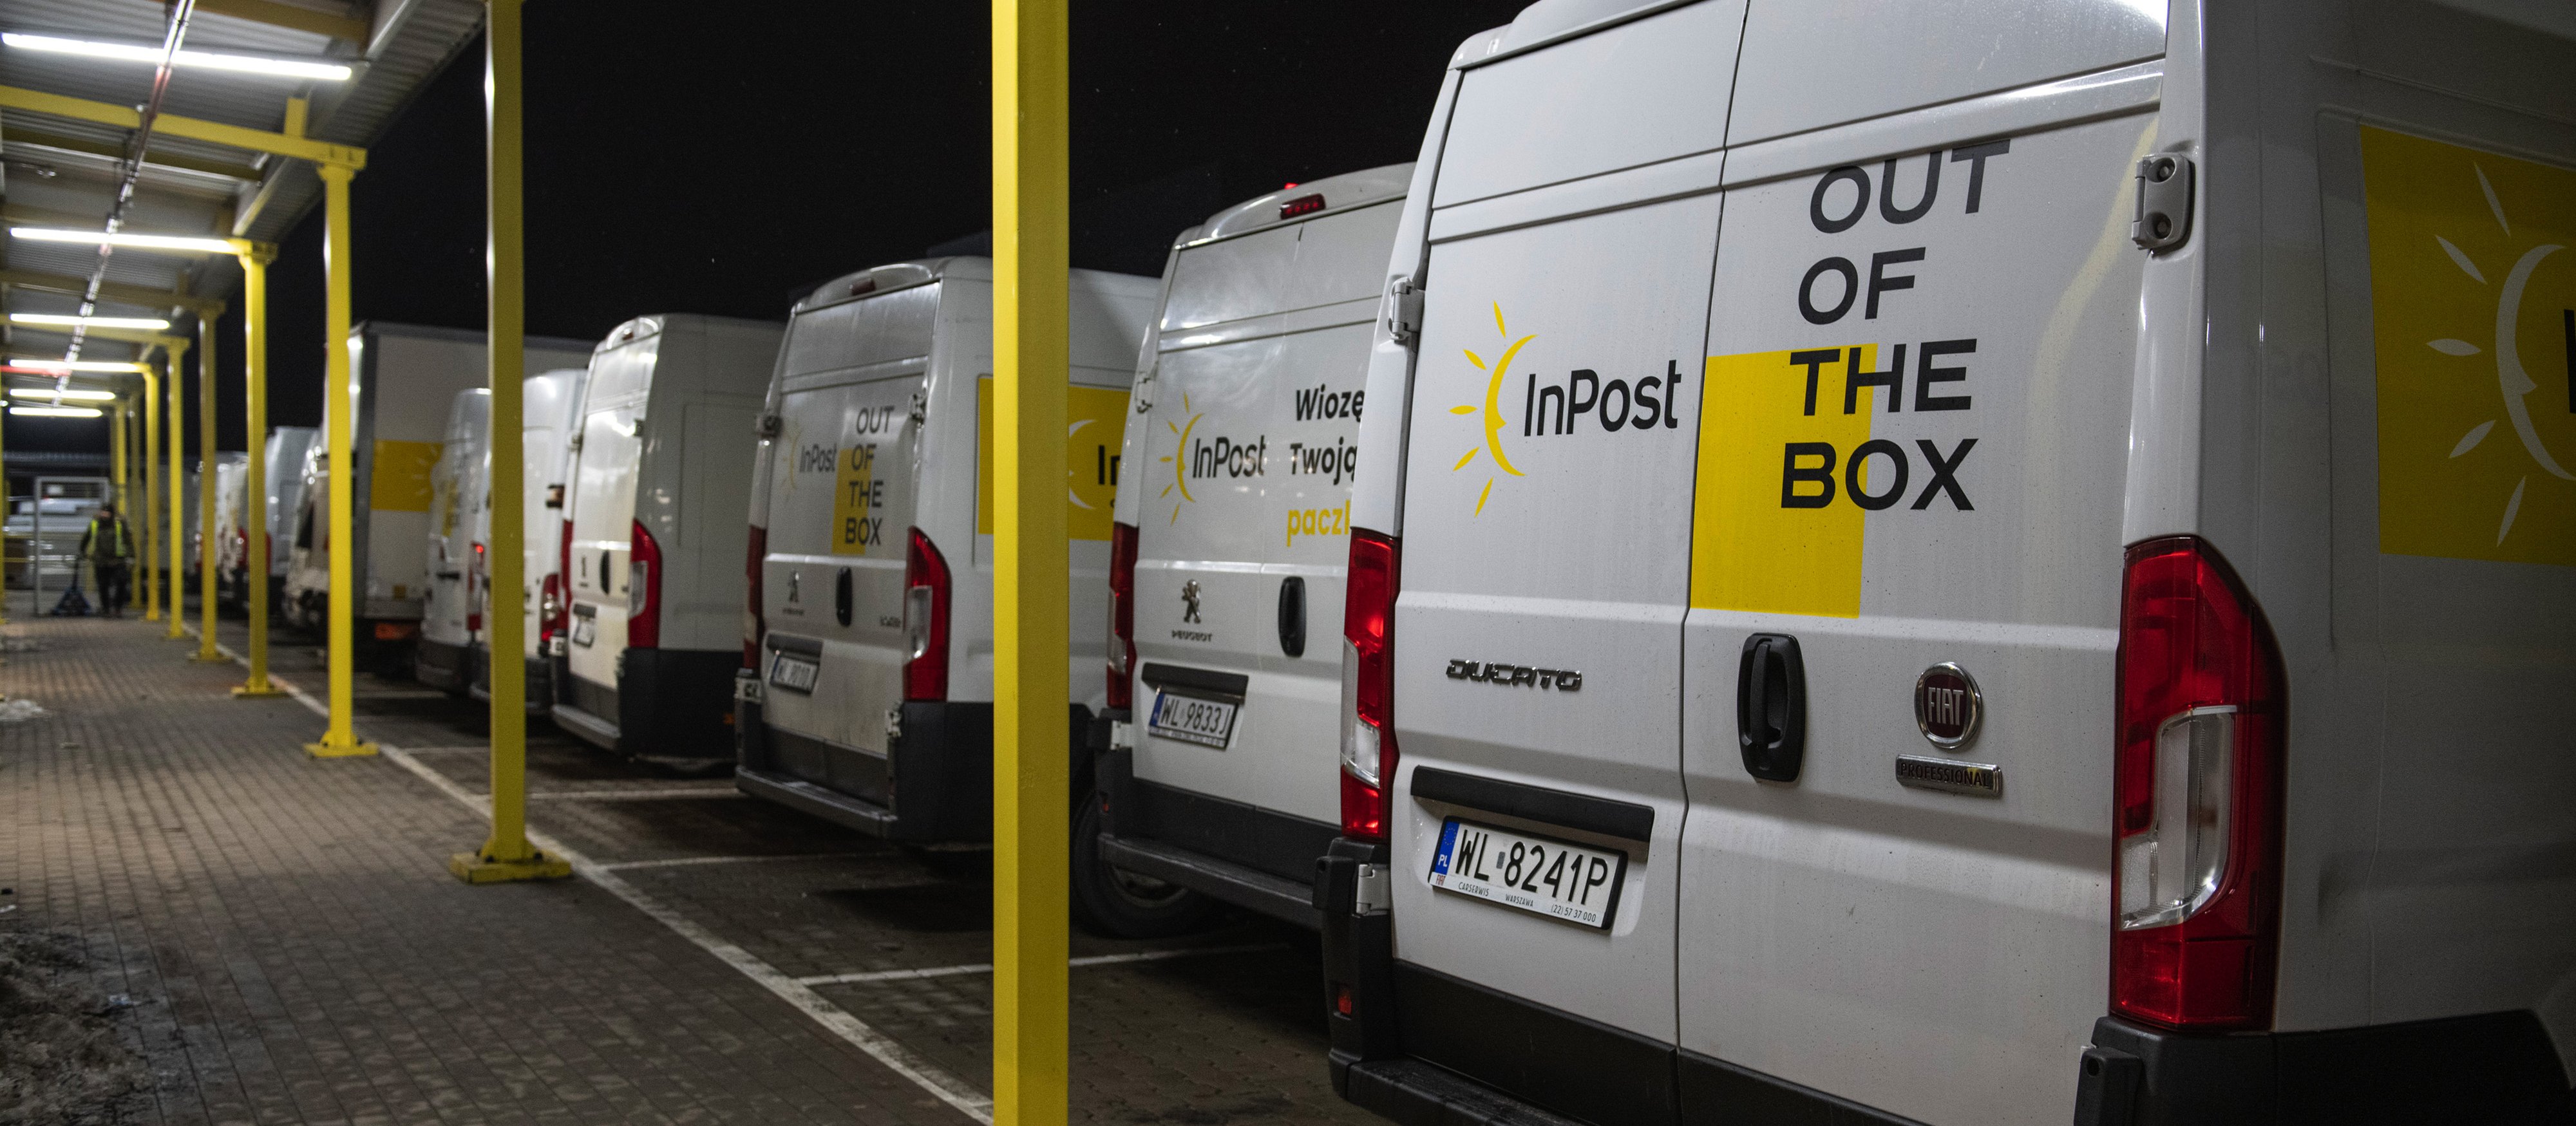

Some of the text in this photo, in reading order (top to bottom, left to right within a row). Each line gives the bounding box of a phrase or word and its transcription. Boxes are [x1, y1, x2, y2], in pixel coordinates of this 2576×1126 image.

[1810, 140, 2010, 234] OUT
[1798, 247, 1926, 324] OF
[1790, 339, 1977, 417] THE
[1296, 384, 1365, 422] Wiozę
[1524, 360, 1681, 436] InPost
[857, 405, 895, 435] OUT
[800, 444, 837, 473] InPost
[851, 444, 877, 471] OF
[1193, 435, 1266, 478] InPost
[1781, 438, 1979, 511] BOX
[849, 480, 884, 507] THE
[845, 517, 882, 546] BOX
[1446, 659, 1582, 691] DUCATO
[1161, 697, 1231, 735] WL 9833J
[1927, 686, 1964, 726] FIAT
[1900, 763, 1989, 787] PROFESSIONAL
[1438, 854, 1448, 868] PL
[1455, 829, 1608, 905] WL 8241P
[1435, 874, 1446, 886] FIAT
[1458, 881, 1490, 897] CARSERWIS
[1505, 894, 1534, 908] WARSZAWA
